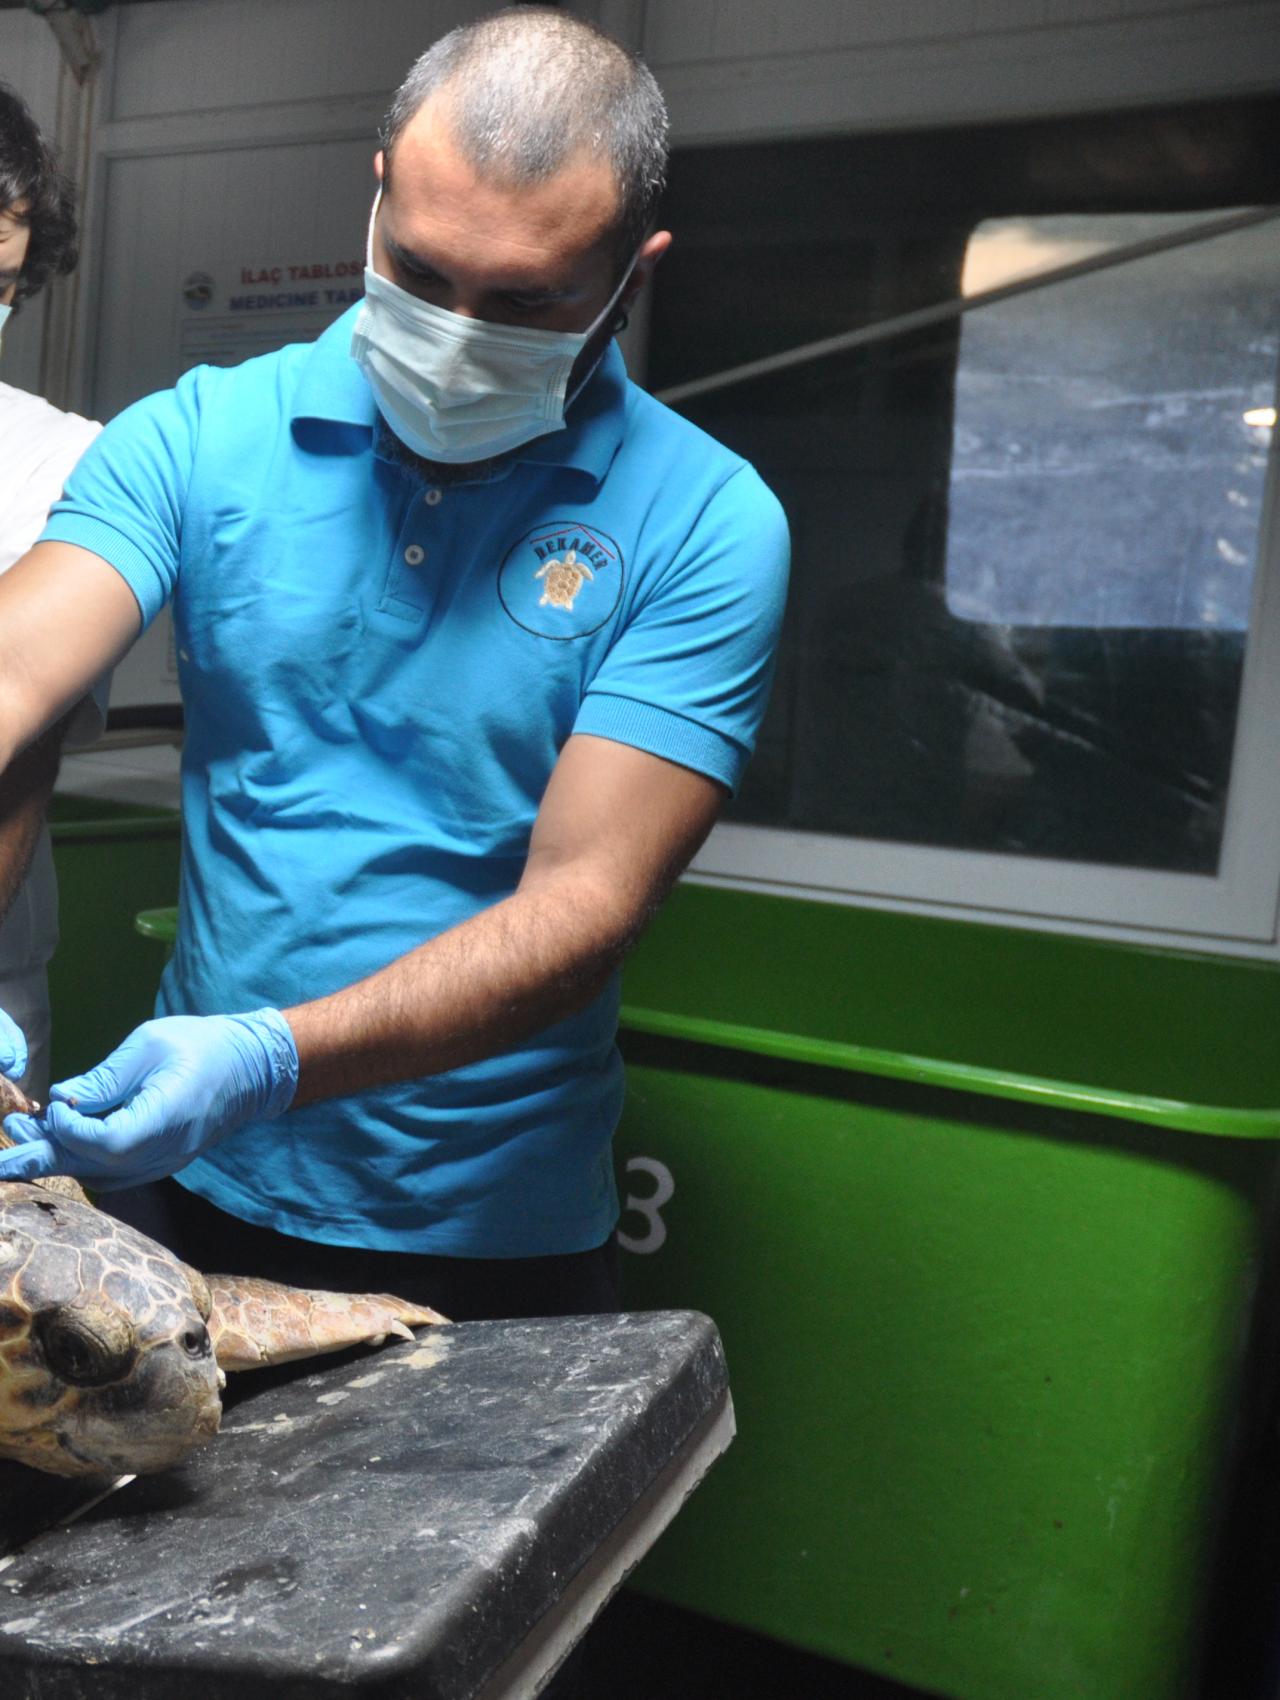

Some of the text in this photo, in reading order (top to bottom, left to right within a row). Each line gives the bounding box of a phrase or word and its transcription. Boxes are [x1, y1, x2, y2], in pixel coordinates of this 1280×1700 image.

[288, 260, 367, 280] TABLOS
[229, 288, 366, 311] MEDICINE TAB
[617, 1156, 675, 1254] 3
